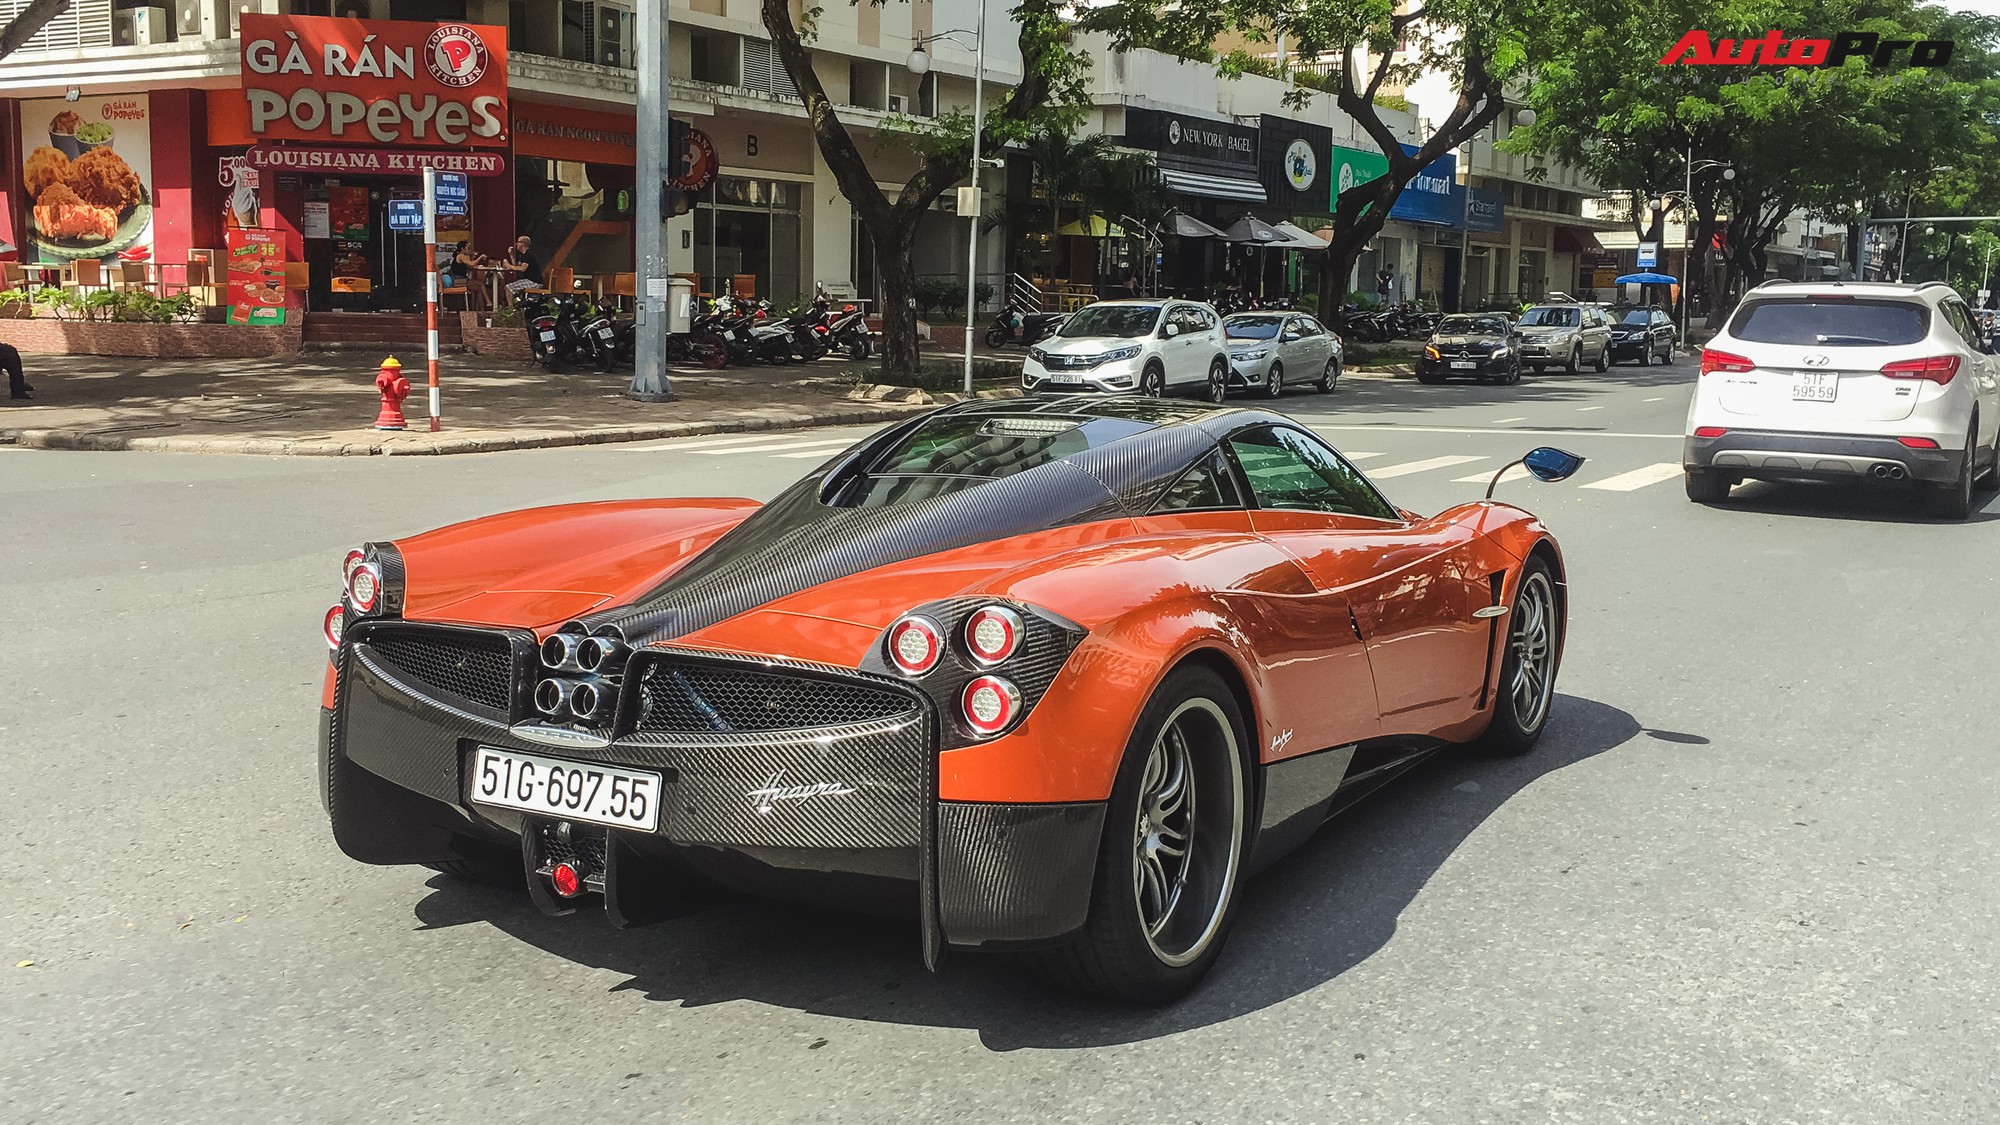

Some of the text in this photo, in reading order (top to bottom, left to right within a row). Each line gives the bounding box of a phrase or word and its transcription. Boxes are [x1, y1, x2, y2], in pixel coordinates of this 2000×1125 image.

[428, 27, 484, 54] LOUISIANA
[246, 31, 415, 80] GÀ RÁN
[430, 63, 482, 85] KITCHEN
[566, 127, 600, 142] NGON
[747, 134, 758, 156] B
[1183, 128, 1251, 152] NEW YORK BAGEL
[254, 150, 497, 171] LOUISIANA KITCHEN
[1803, 373, 1828, 385] 51F
[481, 755, 649, 821] 51G-697.55
